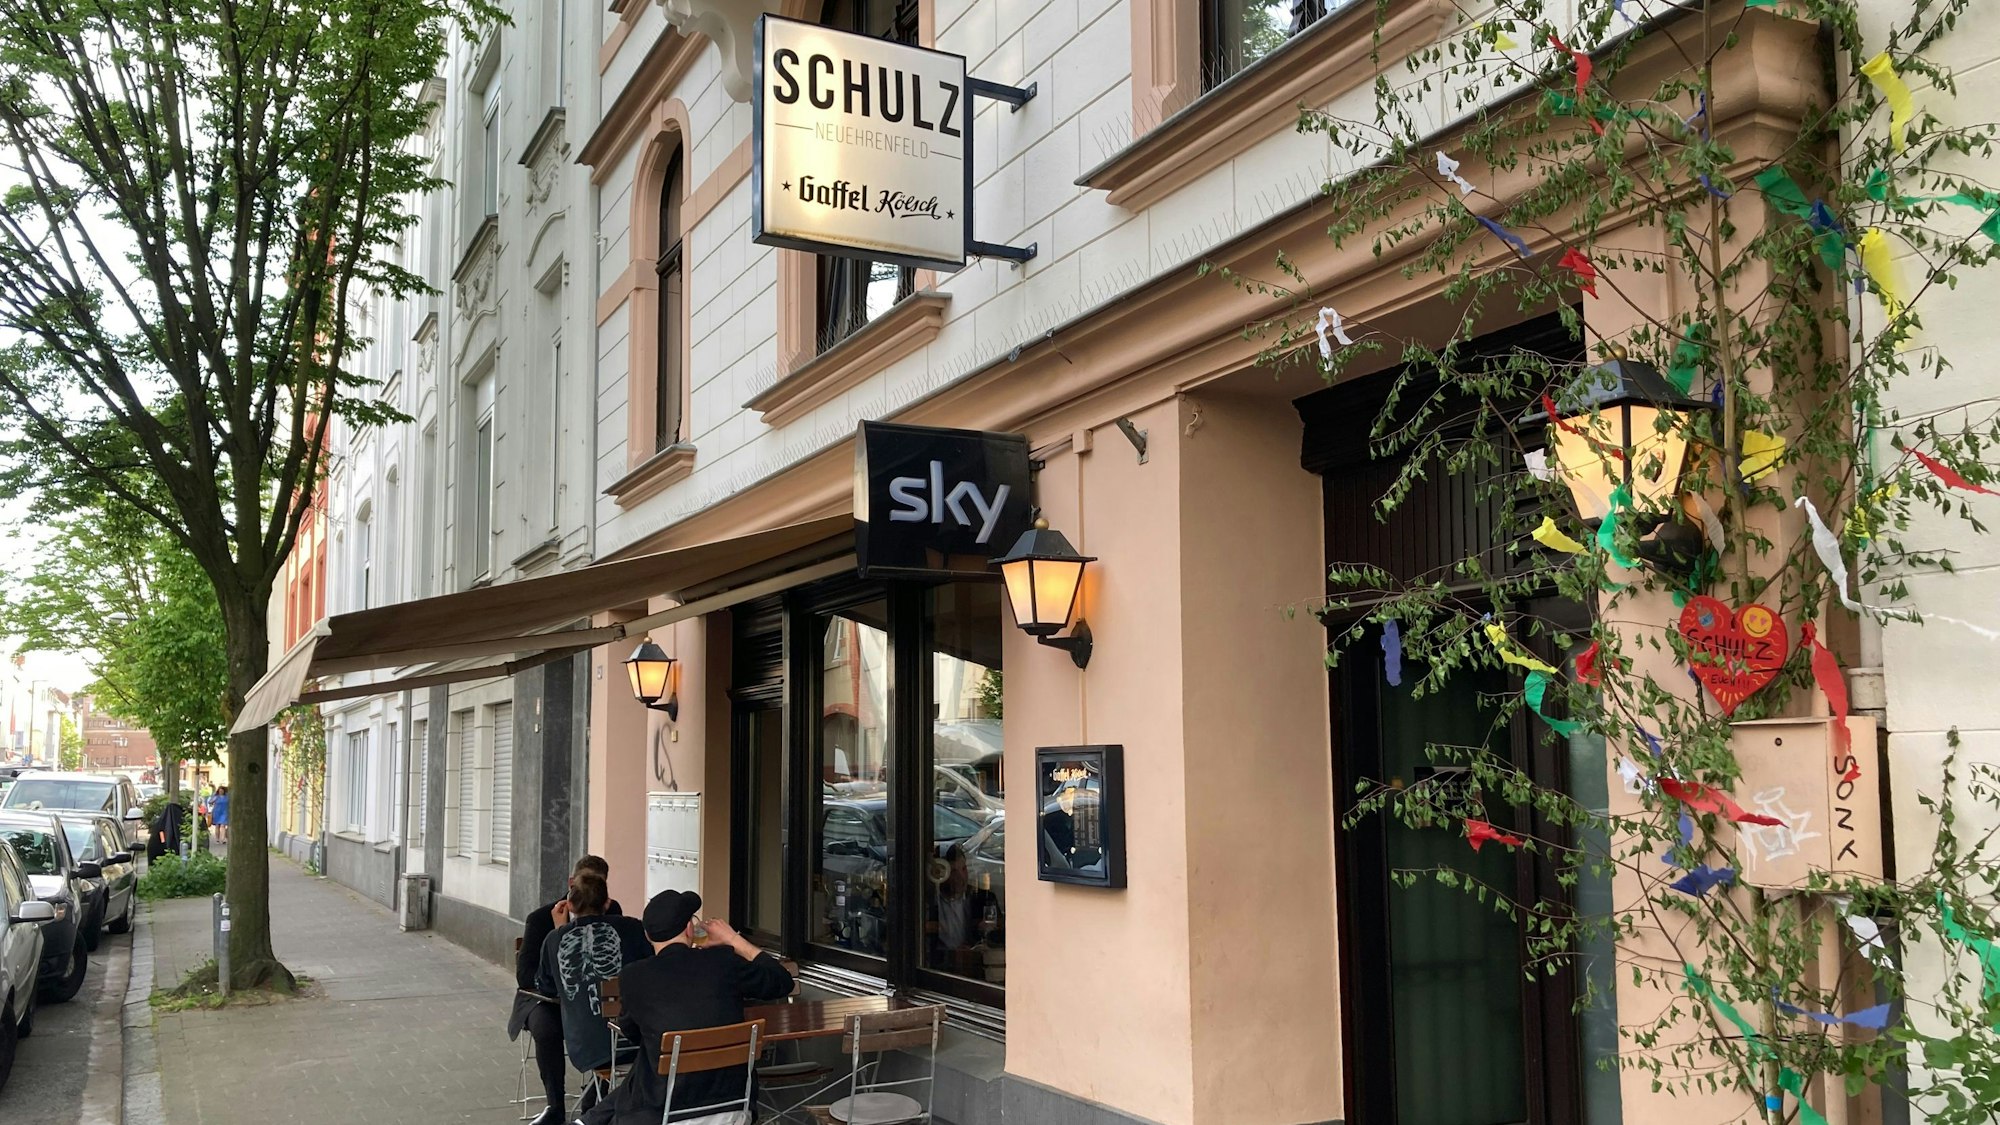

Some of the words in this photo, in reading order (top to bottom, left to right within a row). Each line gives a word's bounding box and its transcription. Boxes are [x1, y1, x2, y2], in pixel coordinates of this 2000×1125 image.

[772, 48, 962, 138] SCHULZ
[815, 121, 929, 160] NEUEHRENFELD
[799, 174, 870, 213] Gaffel
[873, 189, 942, 220] Kölsch
[888, 459, 1012, 544] sky
[1686, 628, 1774, 661] SCHULZ
